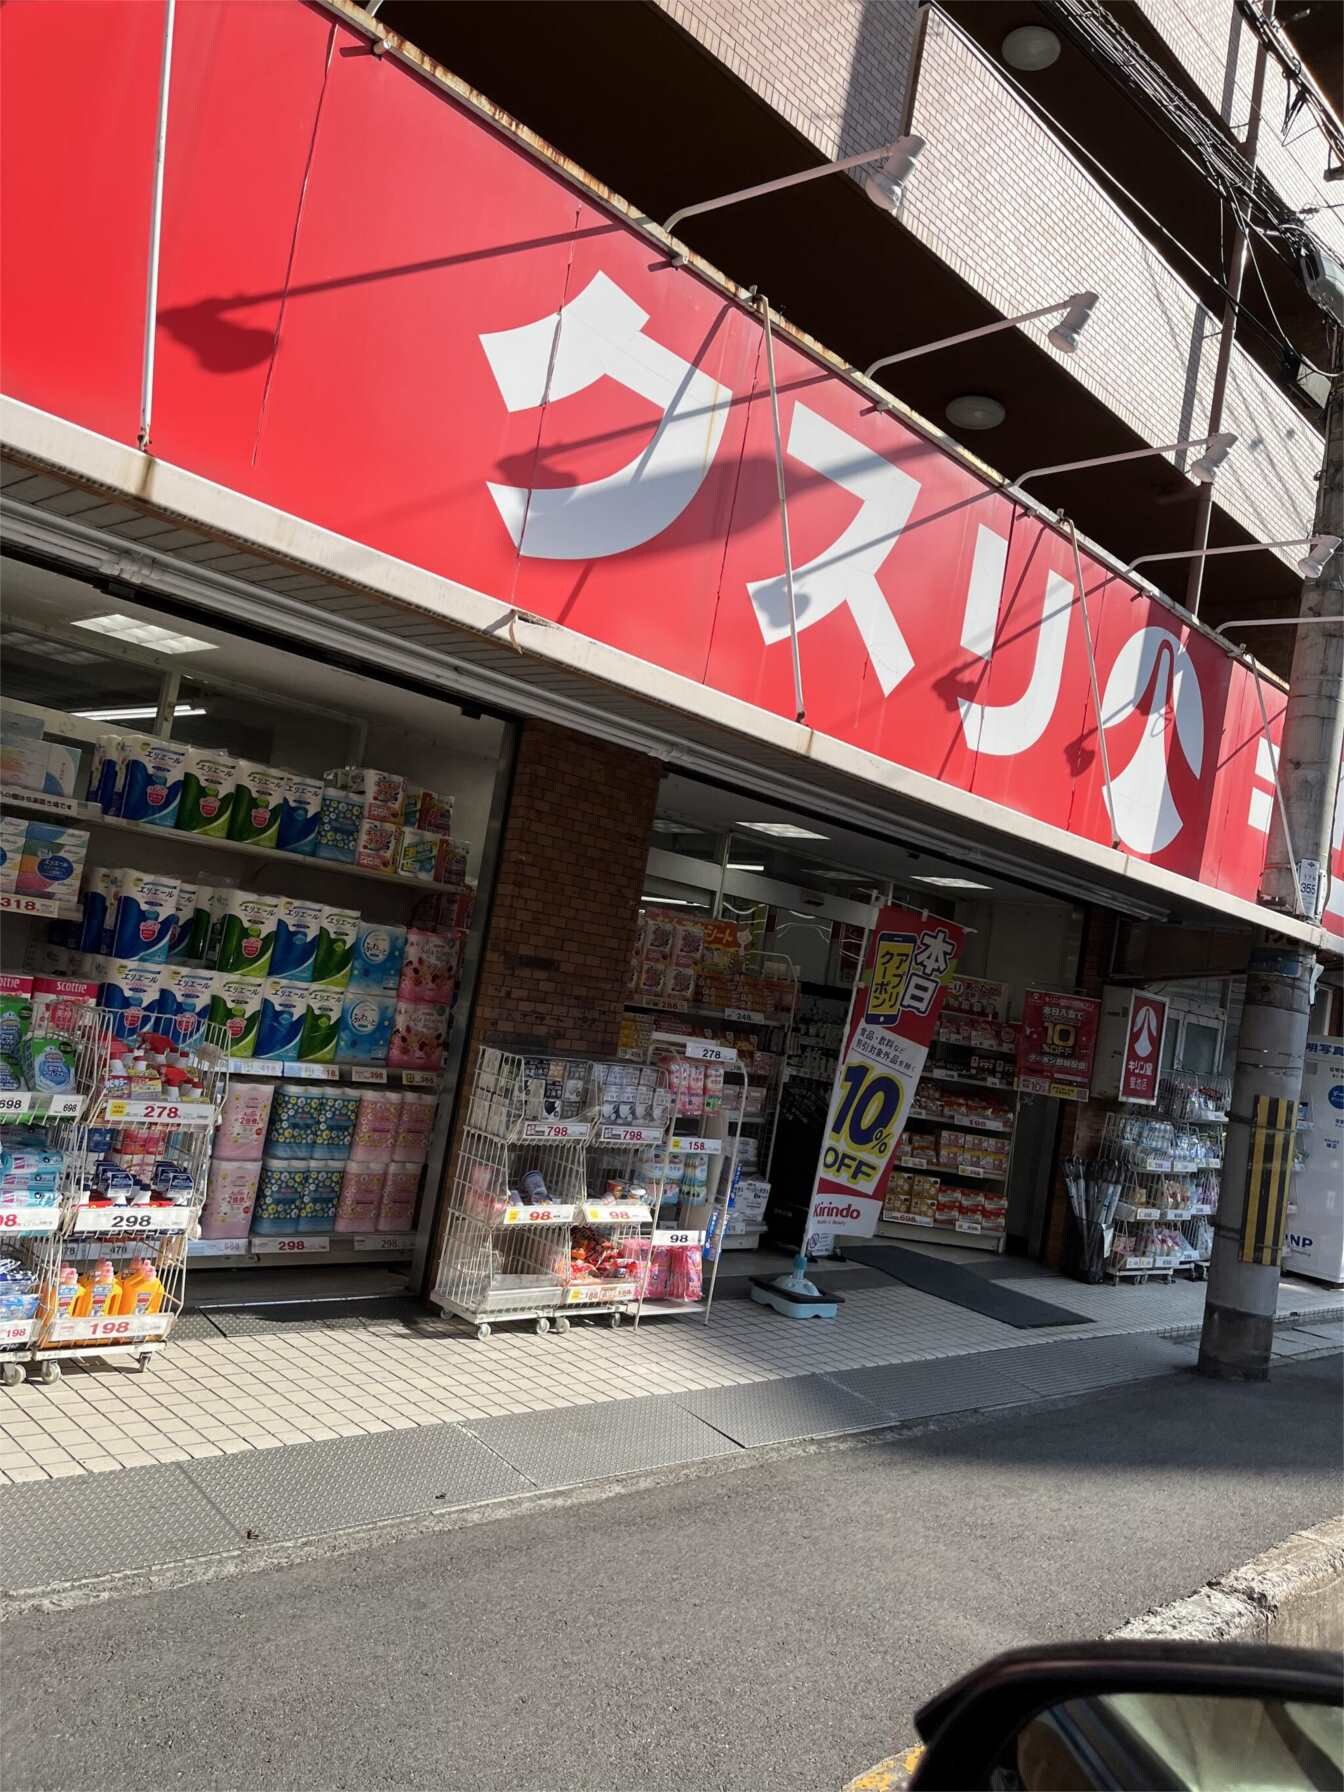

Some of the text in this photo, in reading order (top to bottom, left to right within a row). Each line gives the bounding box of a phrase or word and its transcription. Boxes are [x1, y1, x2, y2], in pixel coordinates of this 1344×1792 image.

[478, 269, 1074, 757] クスリ
[901, 929, 955, 1014] 本日
[872, 950, 894, 1008] クーポン
[702, 1048, 721, 1059] 278
[63, 1103, 78, 1113] 698
[547, 1126, 568, 1137] 798
[623, 1130, 642, 1141] 798
[688, 1141, 705, 1151] 158
[823, 1146, 876, 1180] OFF
[111, 1215, 152, 1228] 298
[670, 1234, 689, 1243] 98
[1285, 1234, 1313, 1247] NP
[278, 1241, 305, 1250] 298
[6, 1328, 26, 1338] 198
[89, 1321, 130, 1335] 198
